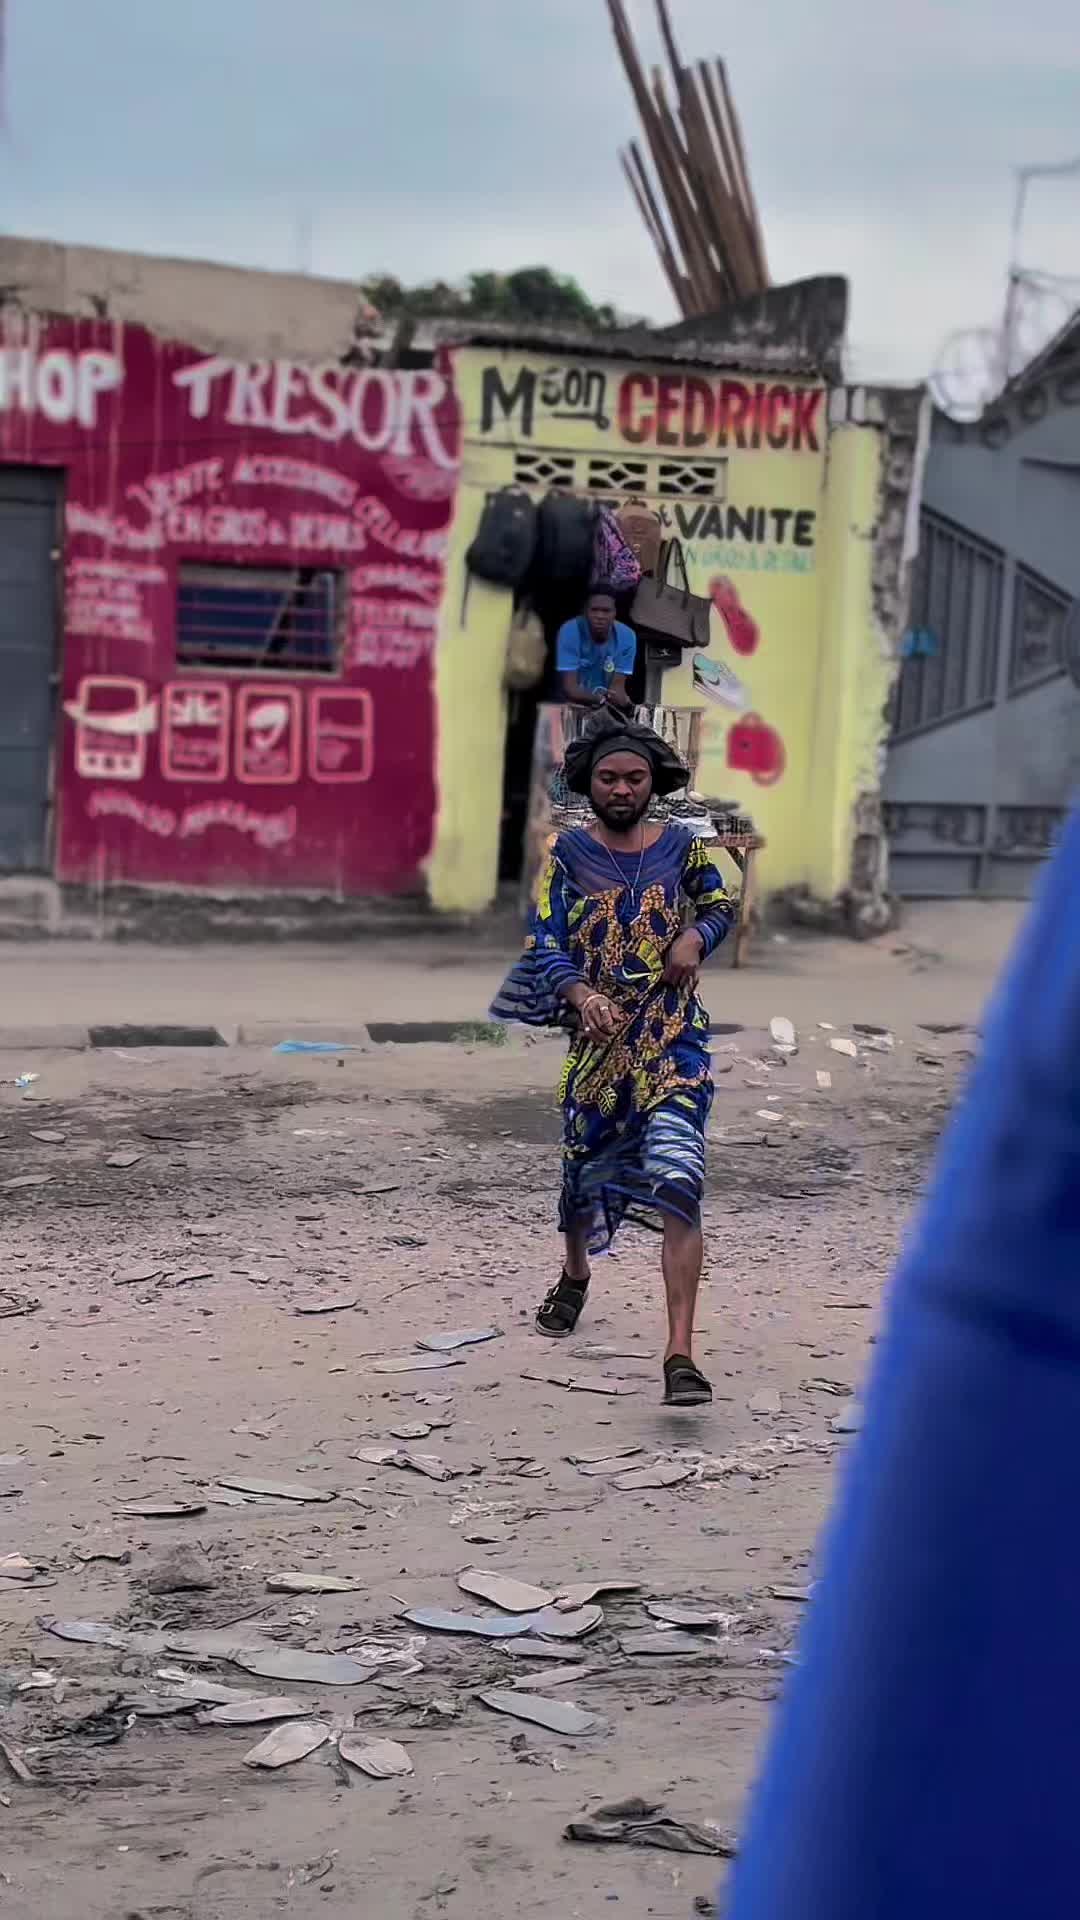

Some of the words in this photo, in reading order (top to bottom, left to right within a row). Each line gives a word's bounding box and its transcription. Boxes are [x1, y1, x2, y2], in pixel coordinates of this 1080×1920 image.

[172, 354, 460, 470] TRESOR
[617, 371, 825, 452] CEDRICK
[673, 502, 817, 548] VANITE
